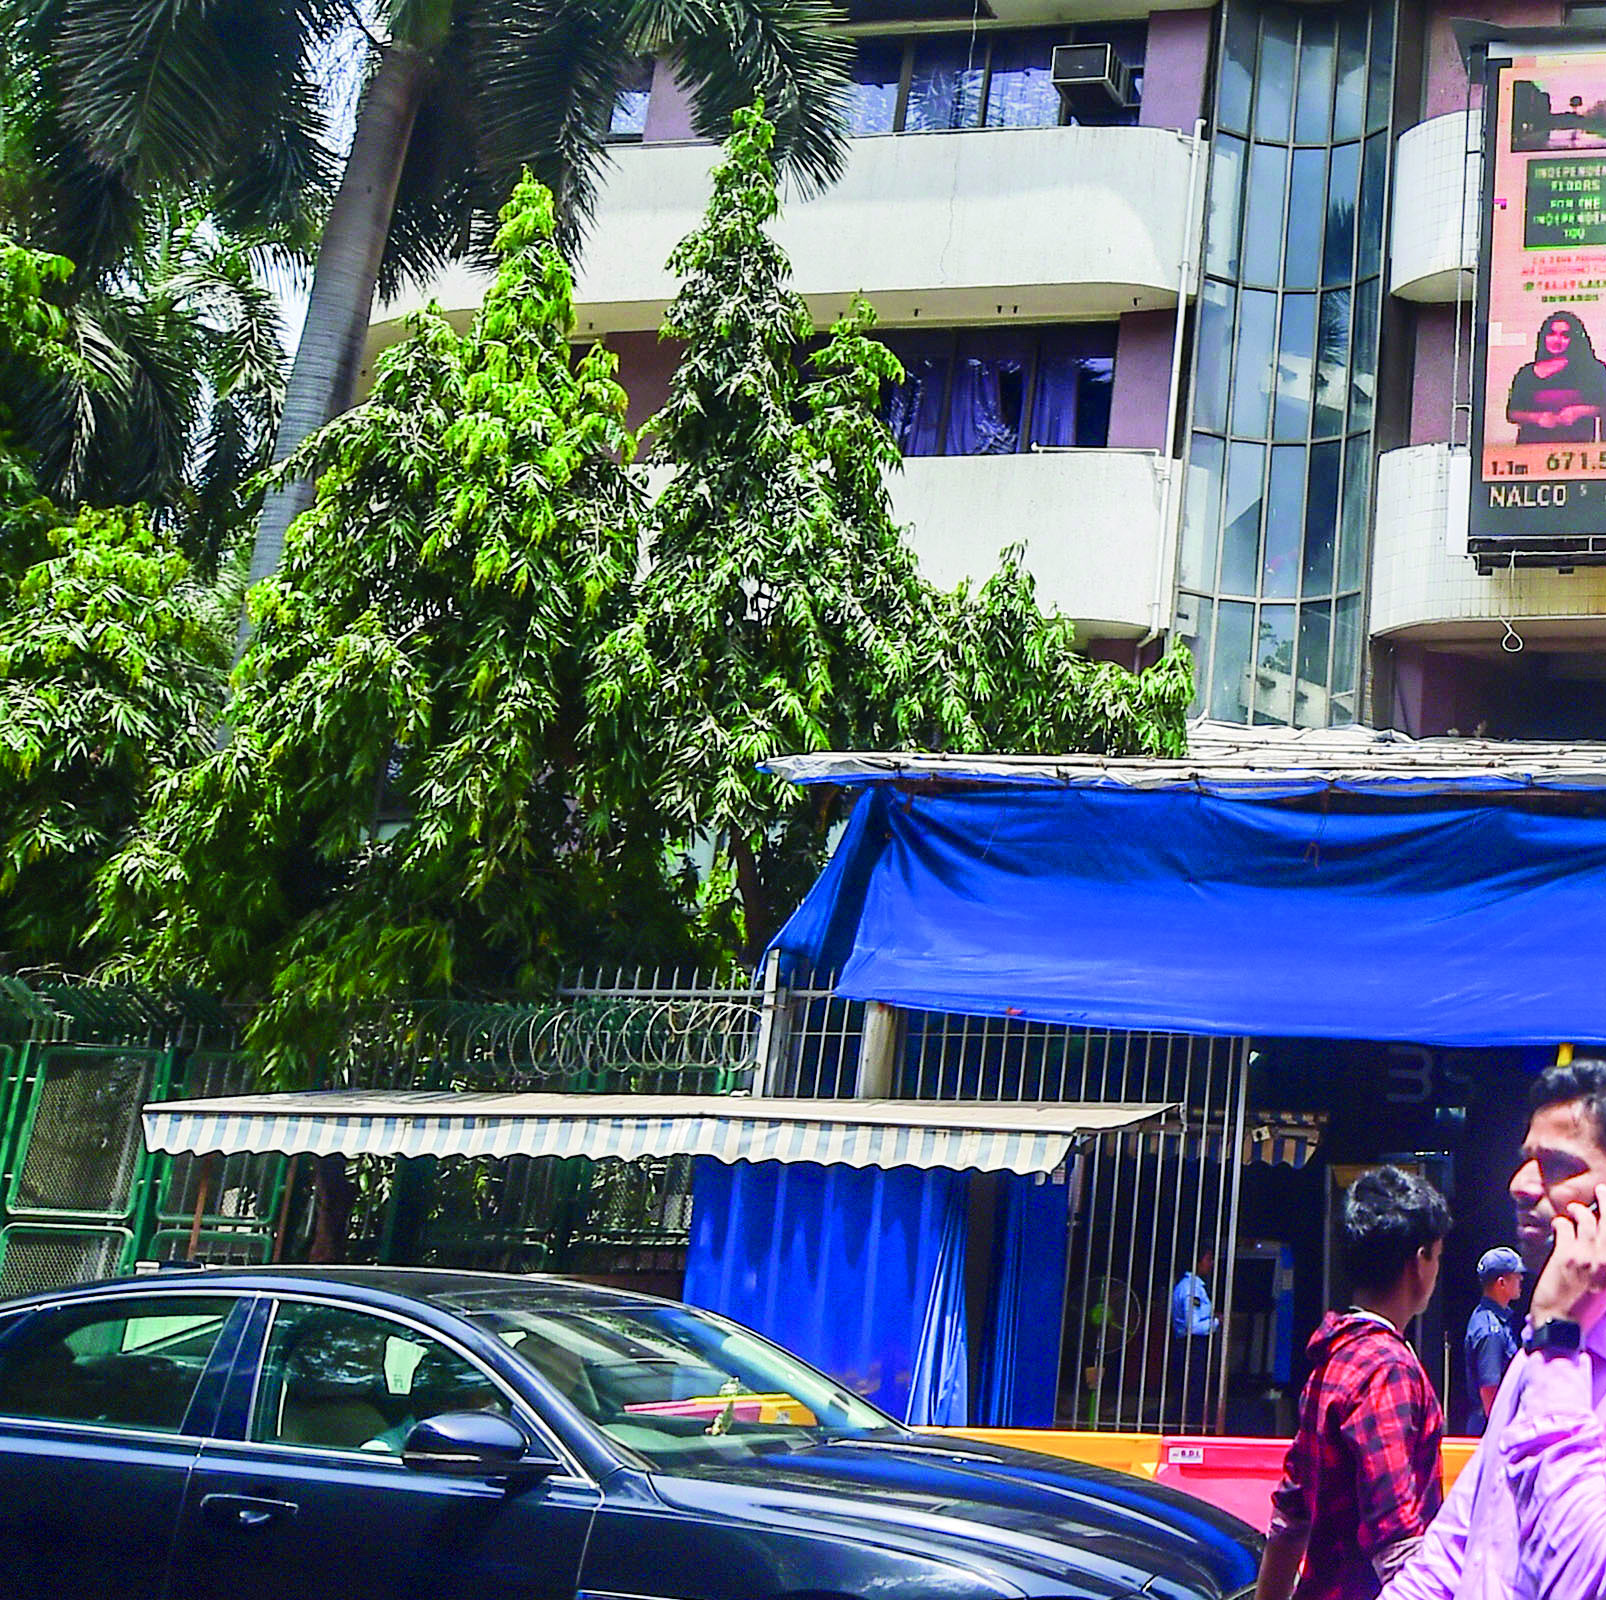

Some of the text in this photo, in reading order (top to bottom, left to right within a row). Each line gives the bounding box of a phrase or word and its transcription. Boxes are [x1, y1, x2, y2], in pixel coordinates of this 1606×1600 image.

[1551, 179, 1601, 192] FLOORS
[1491, 460, 1529, 476] 1.1m
[1489, 484, 1568, 509] NALCO
